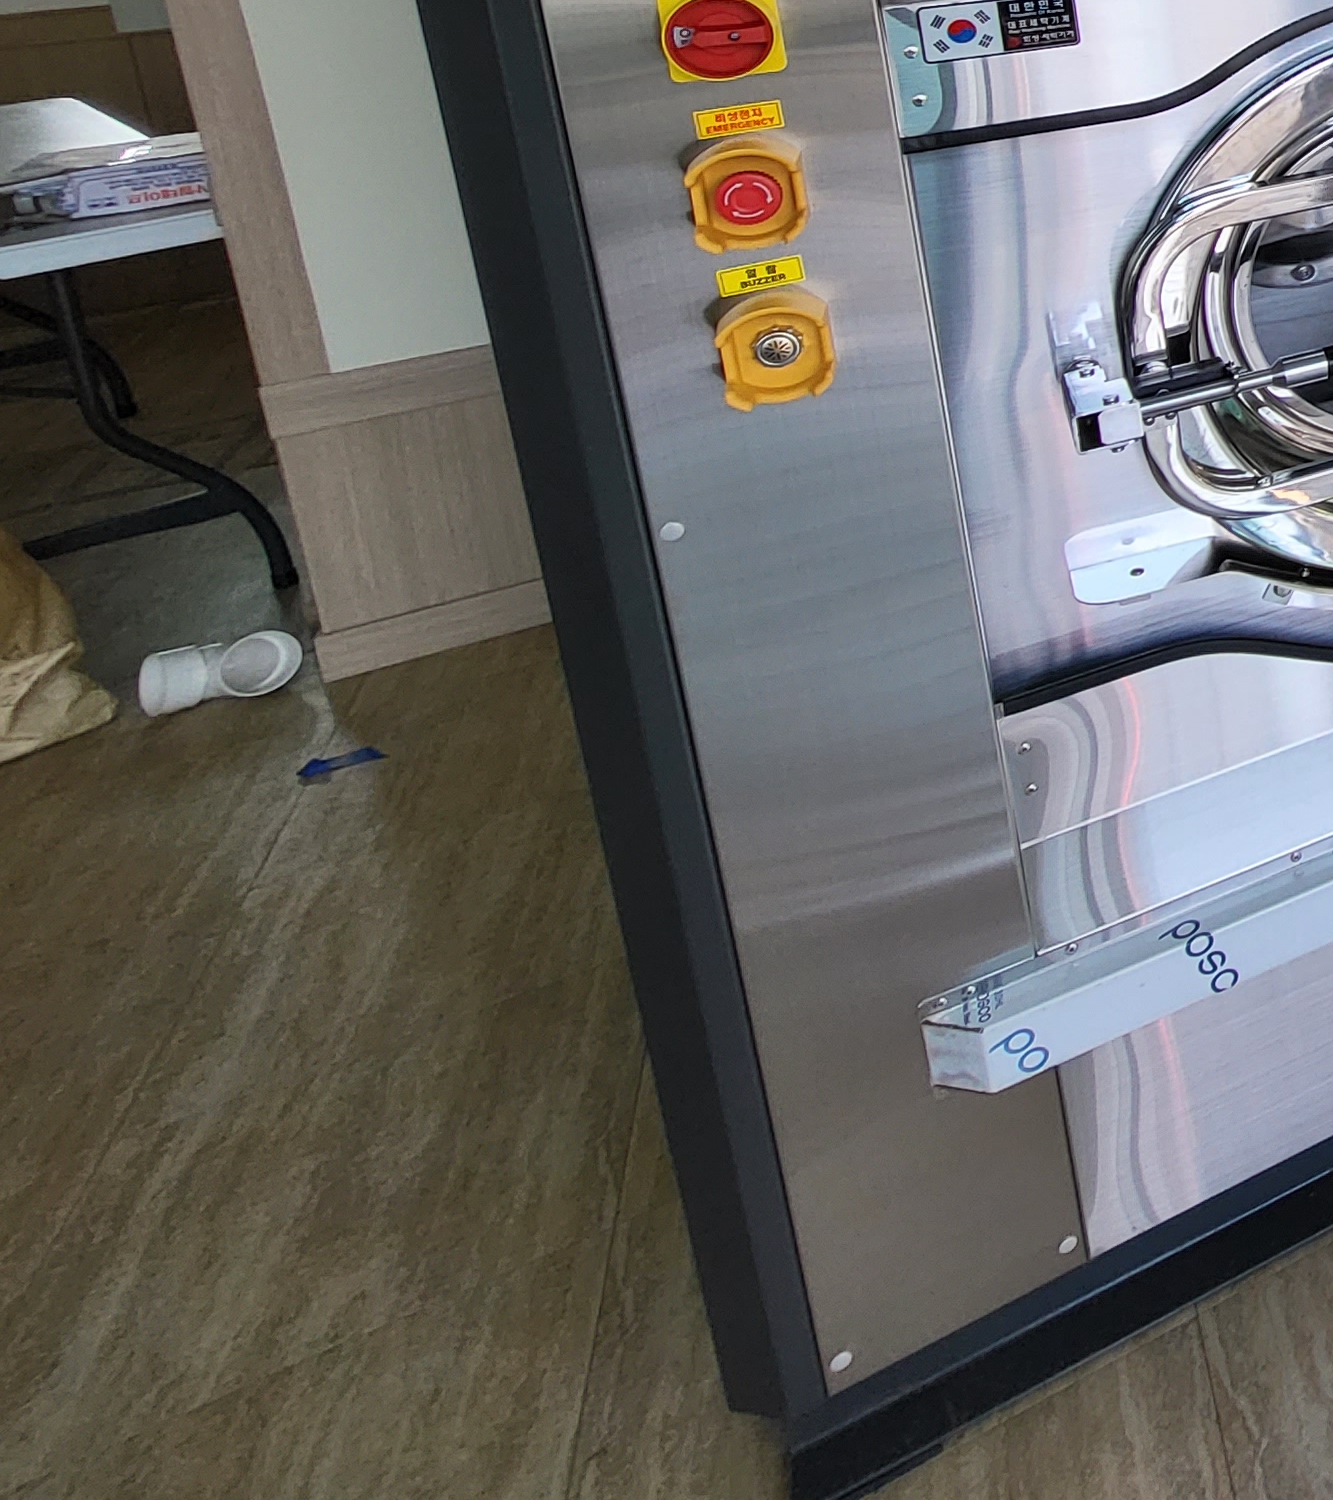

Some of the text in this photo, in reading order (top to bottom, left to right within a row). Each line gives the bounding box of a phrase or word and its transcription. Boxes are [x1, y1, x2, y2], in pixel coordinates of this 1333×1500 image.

[705, 116, 775, 135] EMERGENCY
[740, 273, 786, 289] BUZZER
[1158, 919, 1240, 994] posc
